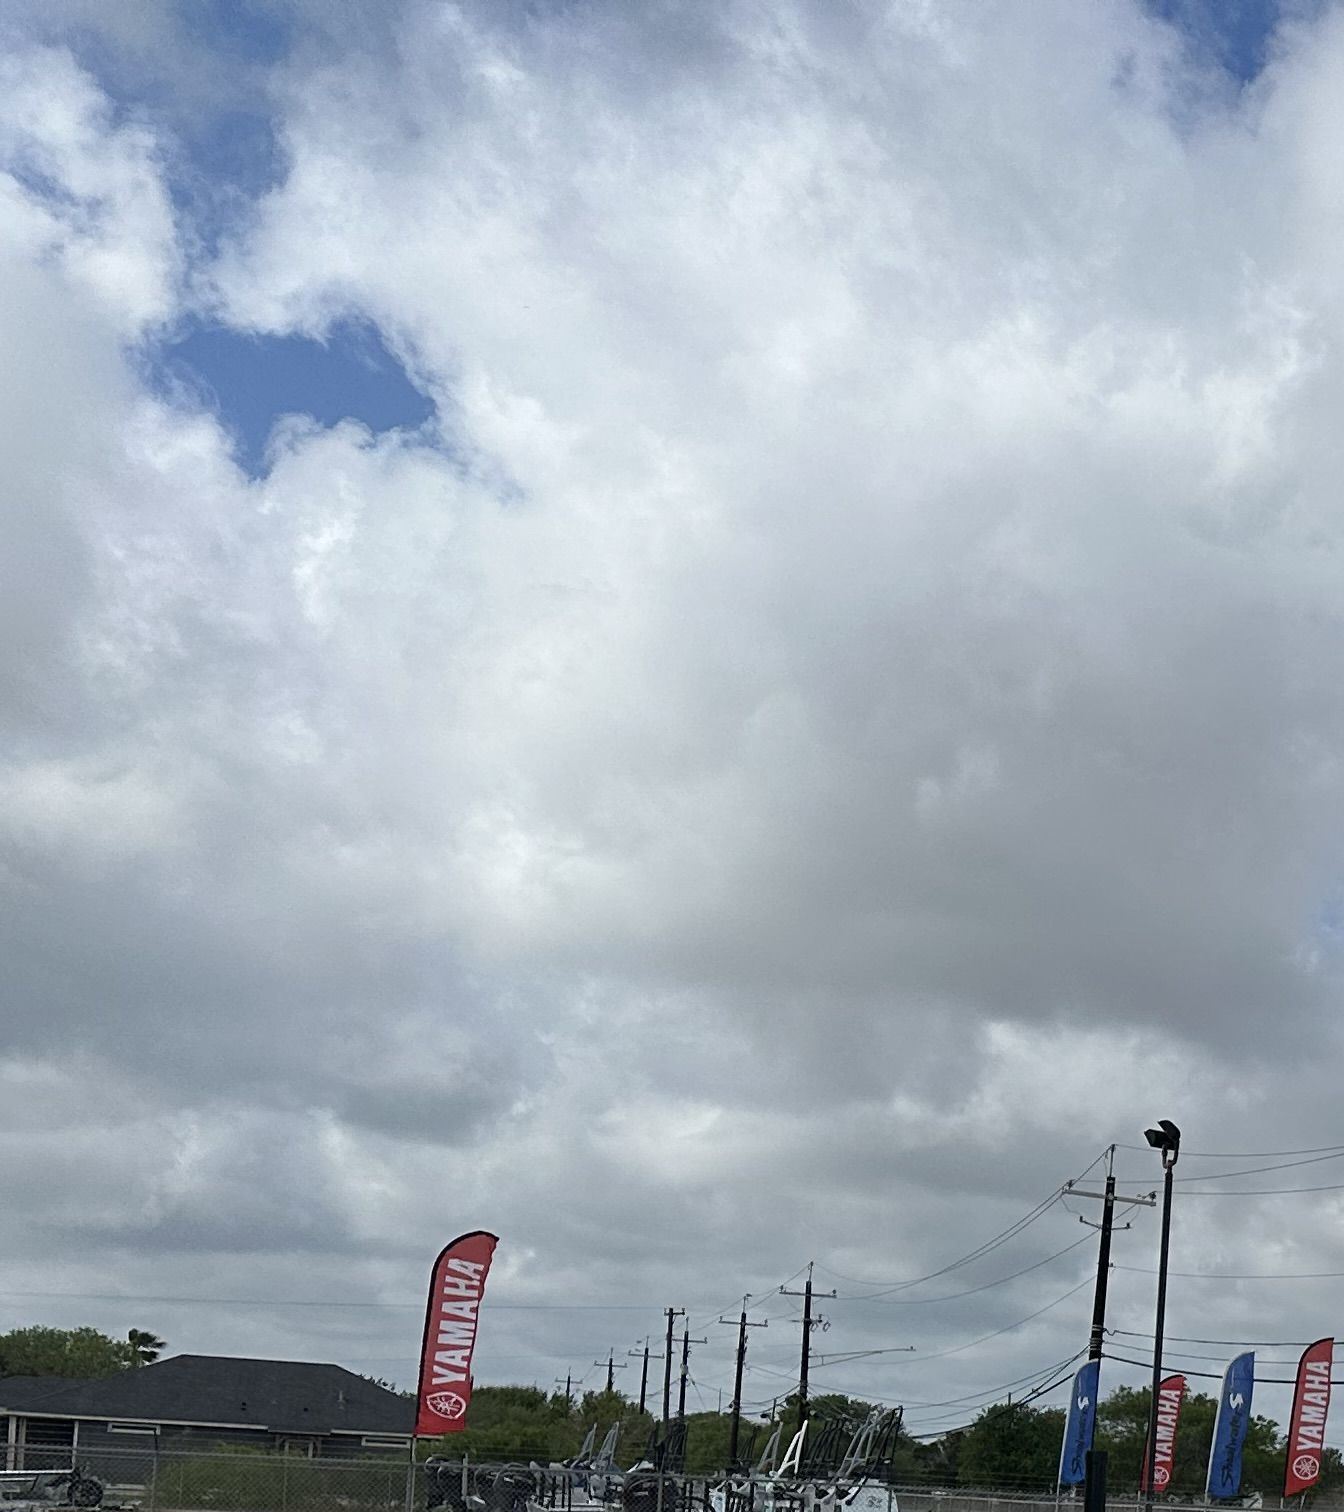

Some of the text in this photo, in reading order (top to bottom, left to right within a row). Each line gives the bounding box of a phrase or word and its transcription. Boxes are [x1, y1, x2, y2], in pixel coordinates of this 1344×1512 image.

[432, 1257, 484, 1385] YAMAHA
[1154, 1389, 1181, 1462] YAMAHA
[1296, 1360, 1329, 1451] YAMAHA
